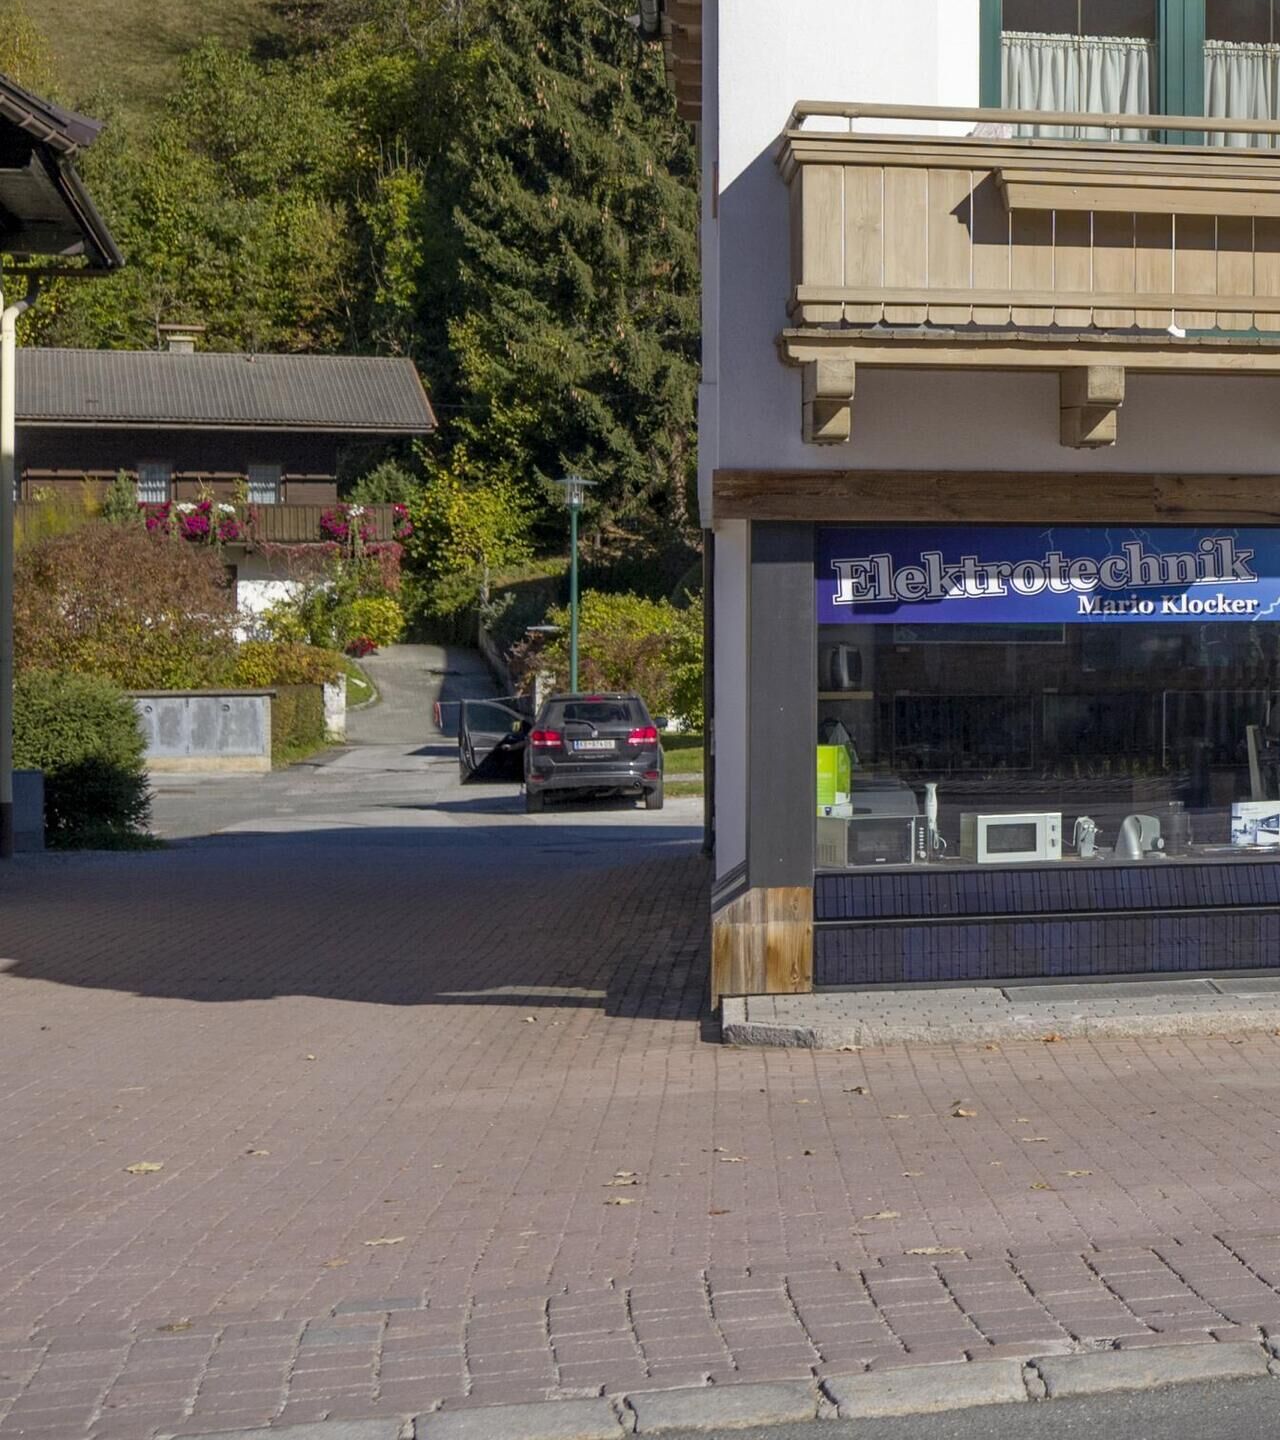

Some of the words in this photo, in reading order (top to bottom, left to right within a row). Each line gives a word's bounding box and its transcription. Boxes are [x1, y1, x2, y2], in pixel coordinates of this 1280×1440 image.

[832, 537, 1259, 606] Elektrotechnik
[1077, 594, 1155, 615] Mario
[1160, 592, 1260, 615] Klocker
